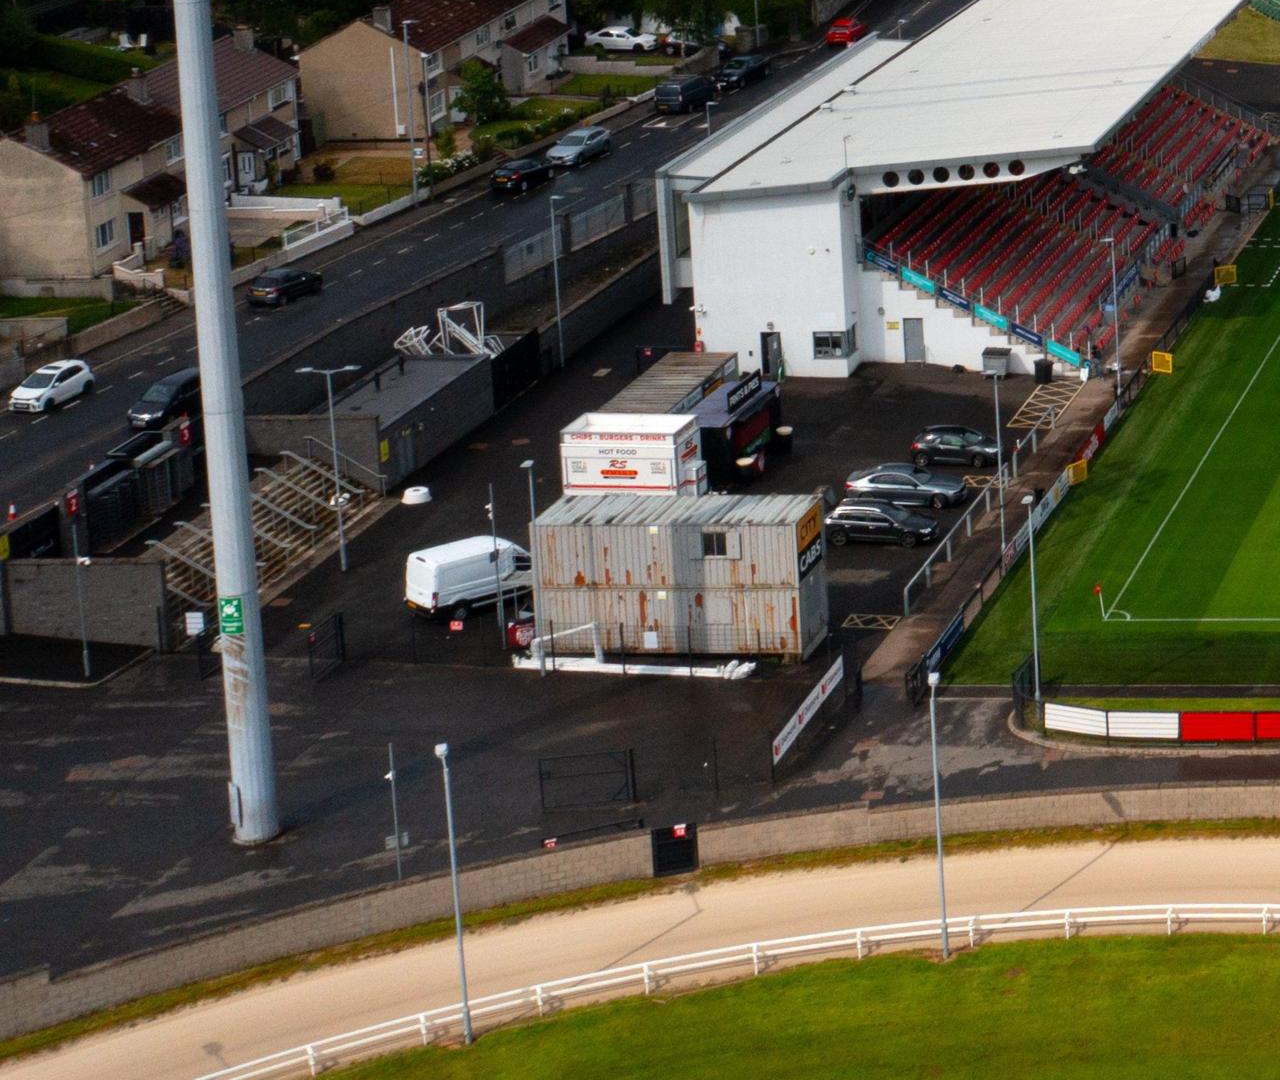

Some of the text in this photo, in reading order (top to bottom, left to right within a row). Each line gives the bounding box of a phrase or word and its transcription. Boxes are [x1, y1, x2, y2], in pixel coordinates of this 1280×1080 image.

[570, 433, 666, 441] CHIPS BURGERS DRINKS
[800, 539, 821, 572] CABS
